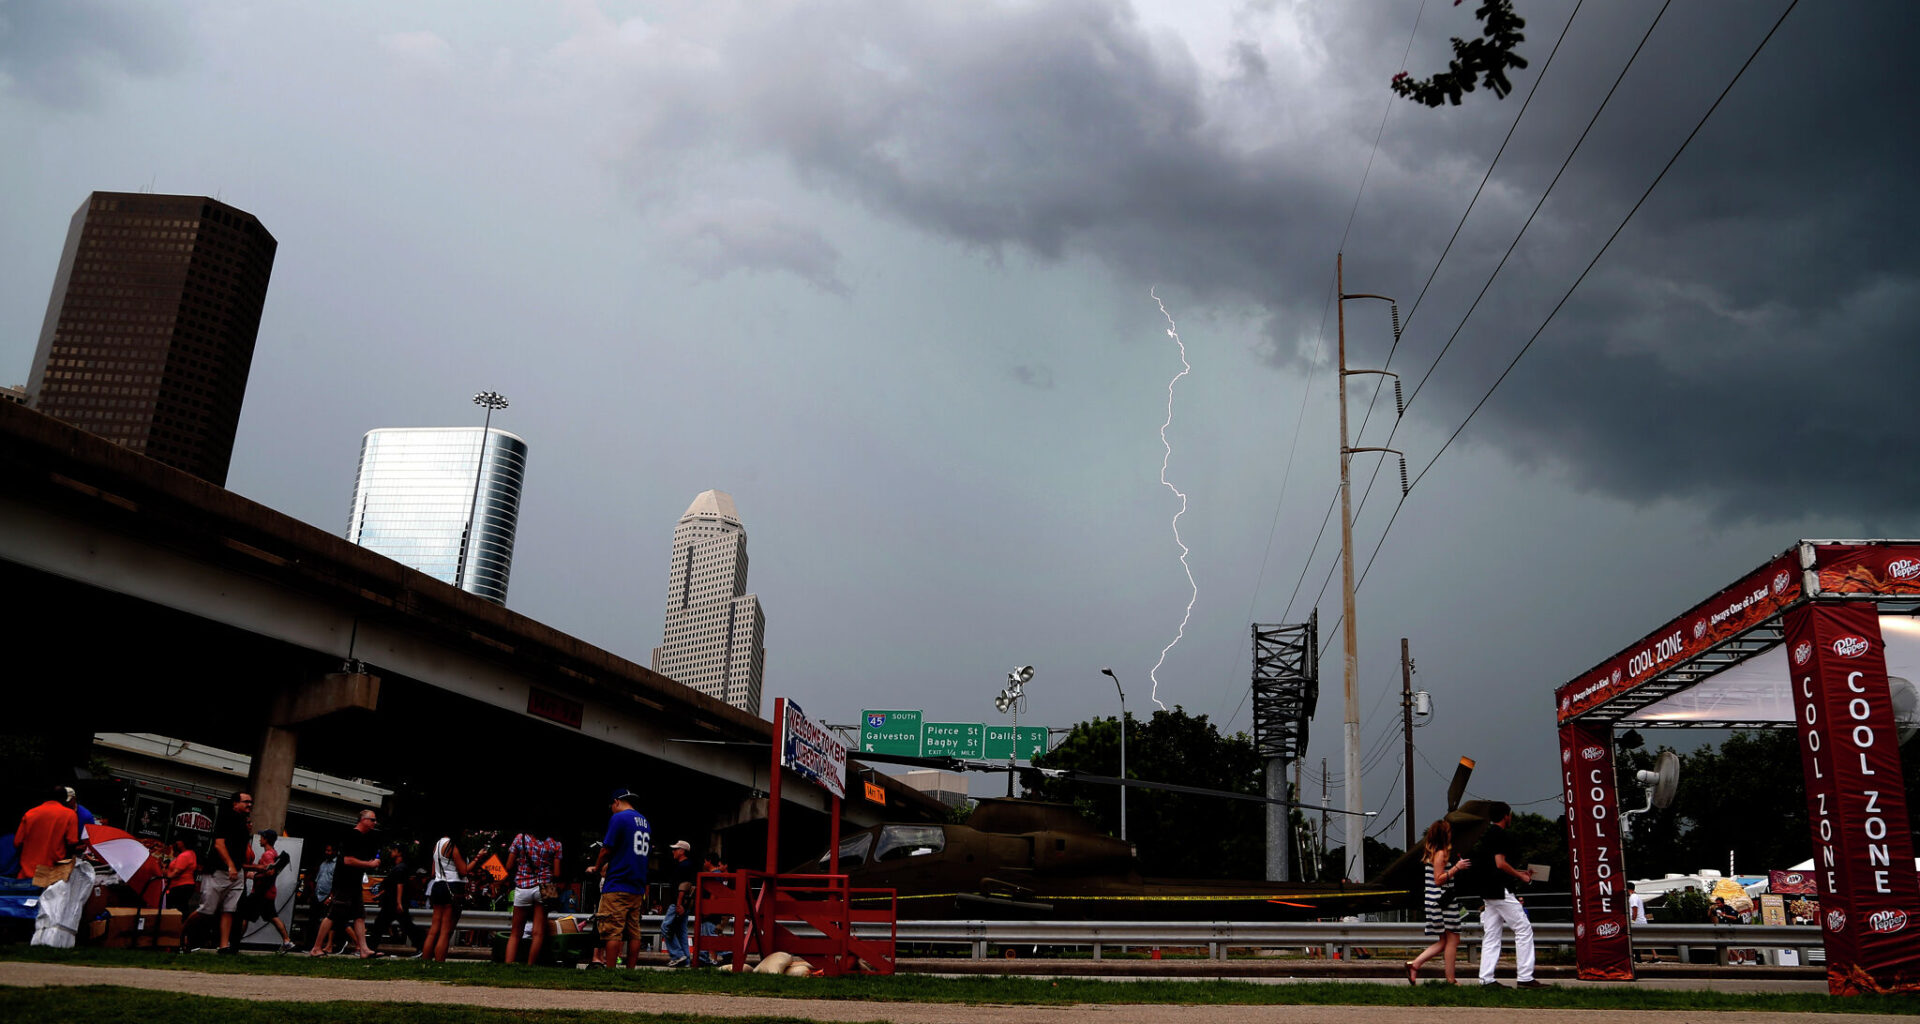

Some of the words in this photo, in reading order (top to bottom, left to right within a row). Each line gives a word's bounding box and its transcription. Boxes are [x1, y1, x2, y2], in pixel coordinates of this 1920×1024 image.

[1889, 561, 1920, 578] Pepper
[1899, 560, 1912, 569] Dr
[1711, 608, 1730, 626] Always
[1729, 603, 1743, 615] One
[1753, 585, 1769, 602] Kind
[1833, 639, 1866, 656] Pepper
[1845, 637, 1857, 647] Dr
[1629, 648, 1654, 678] COOL
[1655, 630, 1684, 663] ZONE
[788, 708, 821, 748] WELCOME
[870, 717, 883, 726] 45
[866, 732, 915, 740] Galveston
[928, 727, 959, 735] Pierce
[990, 732, 1022, 740] Dallas
[927, 738, 958, 748] Bagby
[967, 739, 978, 747] St
[1803, 676, 1823, 779] COOL
[1817, 793, 1837, 893] ZONE
[1847, 671, 1875, 775] COOL
[1863, 790, 1892, 893] ZONE
[1591, 769, 1606, 838] COOL
[633, 830, 651, 857] 66
[1597, 846, 1613, 913] ZONE
[1870, 913, 1904, 931] Pepper
[1881, 910, 1895, 920] Dr
